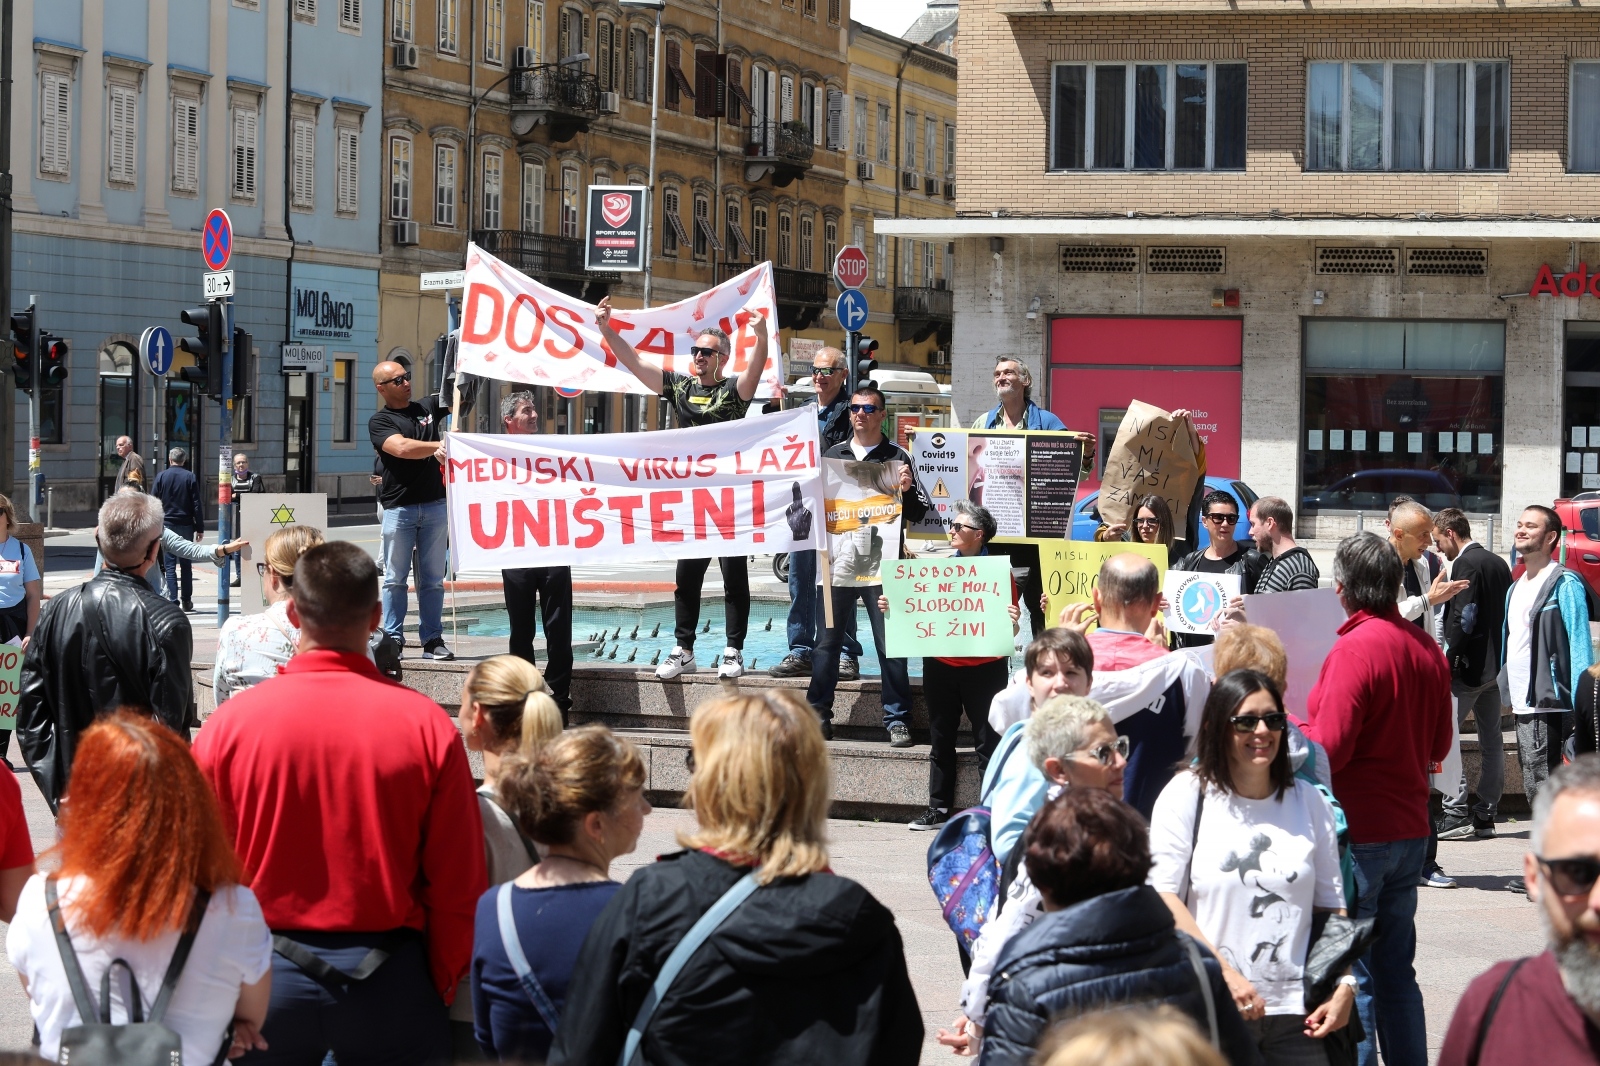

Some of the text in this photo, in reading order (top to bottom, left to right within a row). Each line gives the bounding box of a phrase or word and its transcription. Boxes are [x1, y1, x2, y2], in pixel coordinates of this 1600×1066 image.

[839, 259, 866, 276] STOP
[206, 278, 216, 293] 30
[296, 288, 354, 330] MOLONGO
[461, 282, 675, 372] DOSTA
[285, 348, 322, 361] MOLONGO
[1130, 417, 1177, 444] NISI
[448, 434, 816, 485] MEDIJSKI VIRUS LAŽI
[922, 450, 956, 459] Covid19
[1138, 444, 1164, 468] MI
[919, 464, 959, 474] nije virus
[1120, 462, 1170, 490] VAŠI
[468, 480, 766, 550] UNIŠTEN!
[827, 509, 850, 522] NEĆU
[857, 504, 897, 518] GOTOVO!
[938, 504, 947, 512] ID
[924, 517, 953, 528] projek
[1054, 551, 1088, 561] MISLI
[894, 564, 978, 580] SLOBODA
[913, 582, 931, 593] SE
[938, 582, 957, 593] NE
[905, 597, 985, 614] SLOBODA
[1175, 574, 1200, 632] NE COVID PUTOVNICI
[915, 618, 985, 639] SE ŽIVI
